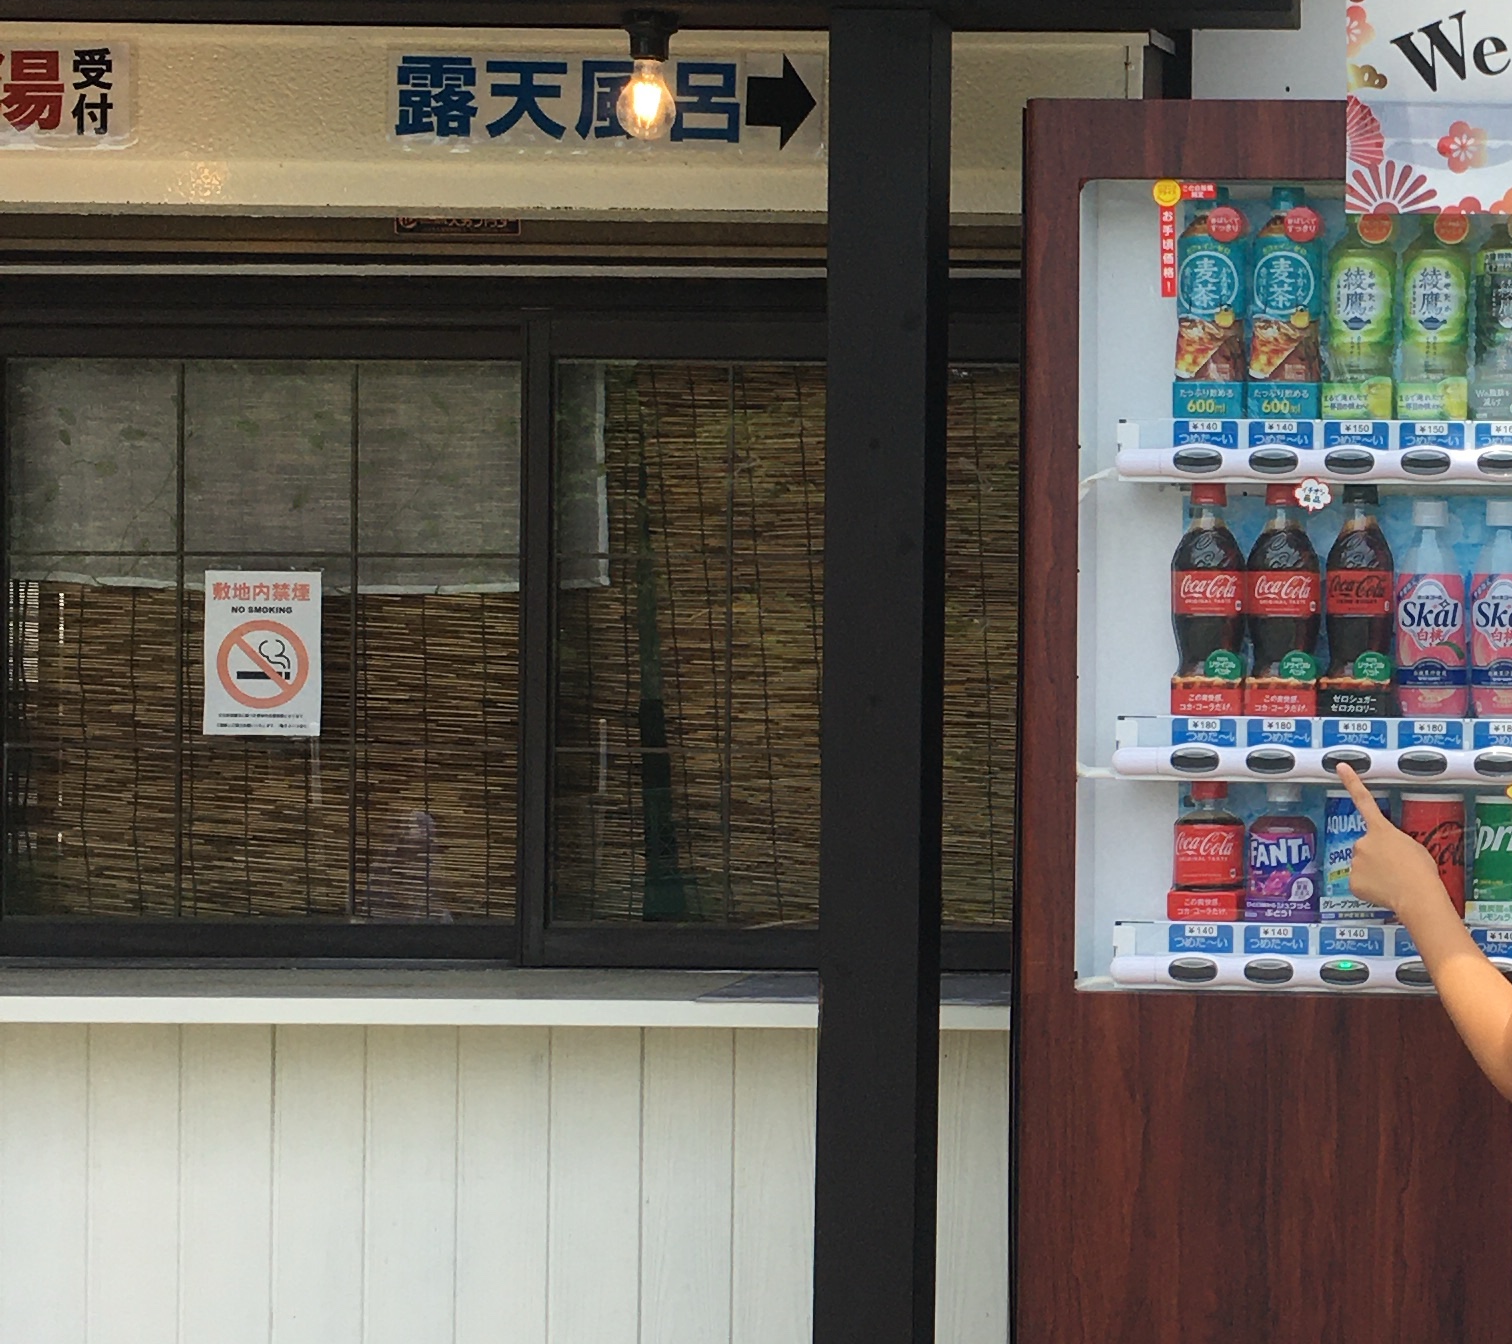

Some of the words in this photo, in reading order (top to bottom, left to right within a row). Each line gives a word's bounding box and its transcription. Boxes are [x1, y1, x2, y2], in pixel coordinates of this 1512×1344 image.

[71, 47, 114, 136] 受付
[395, 55, 741, 143] 露天風呂
[1191, 257, 1219, 308] 麦茶
[1268, 257, 1296, 308] 麦茶
[1343, 267, 1367, 315] 綾鷹
[1418, 267, 1442, 315] 綾鷹
[1190, 423, 1219, 432] ¥140
[1266, 423, 1295, 432] ¥140
[1342, 423, 1371, 433] ¥150
[1417, 425, 1446, 434] ¥150
[212, 582, 311, 602] 敷地内禁煙
[1180, 574, 1237, 598] Coca-Cola
[1254, 575, 1311, 599] Coca-Cola
[1329, 575, 1386, 599] Coca-Cola
[231, 606, 245, 614] NO
[248, 606, 293, 614] SMOKING
[1417, 628, 1444, 642] 白桃
[1332, 694, 1377, 703] ゼロシュガー
[1192, 721, 1218, 729] ¥180
[1267, 721, 1292, 730] ¥180
[1343, 722, 1368, 731] ¥180
[1418, 723, 1443, 732] ¥180
[1327, 815, 1367, 834] AQUAR
[1175, 831, 1234, 856] Coca-Cola
[1251, 838, 1310, 867] FANTA
[1188, 927, 1214, 935] ¥140
[1263, 928, 1288, 936] ¥140
[1339, 929, 1365, 937] ¥140
